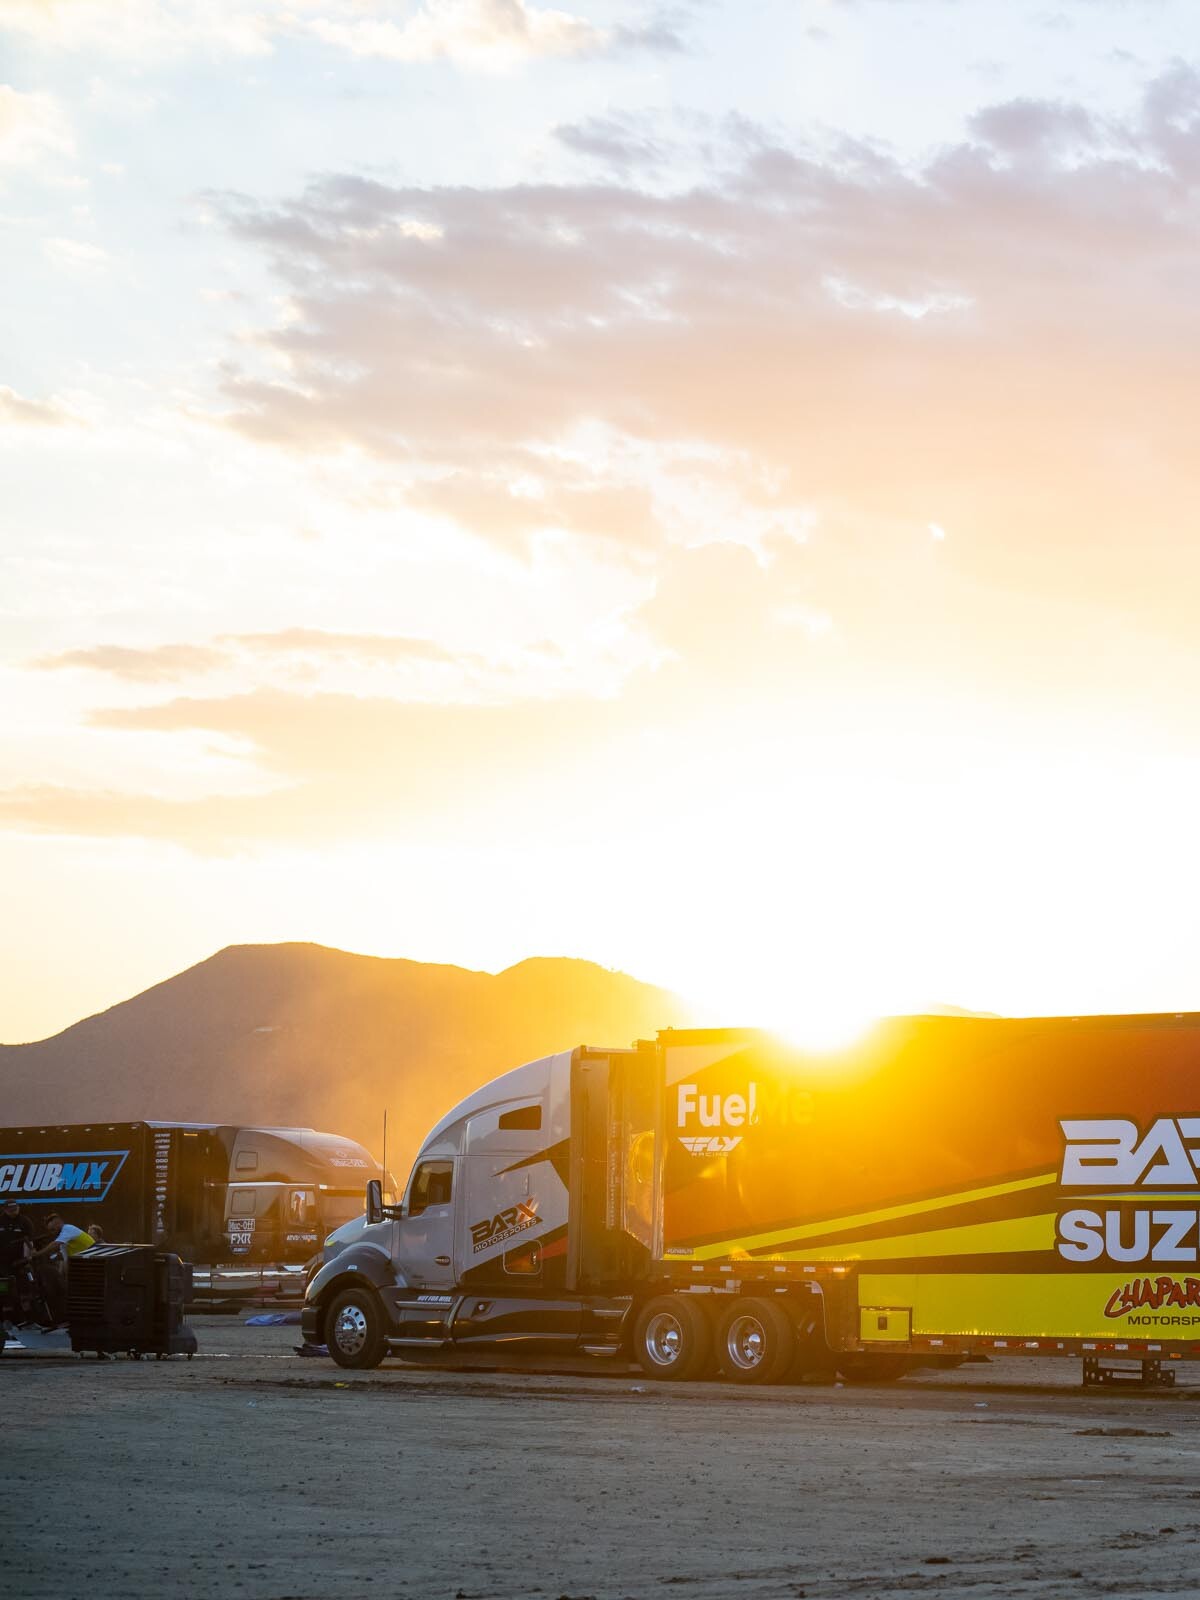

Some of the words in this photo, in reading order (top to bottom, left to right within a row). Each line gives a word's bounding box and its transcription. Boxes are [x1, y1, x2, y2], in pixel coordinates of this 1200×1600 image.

[0, 1162, 109, 1191] CLUBMX
[469, 1198, 536, 1244] BARX
[474, 1217, 538, 1254] MOTORSPORTS
